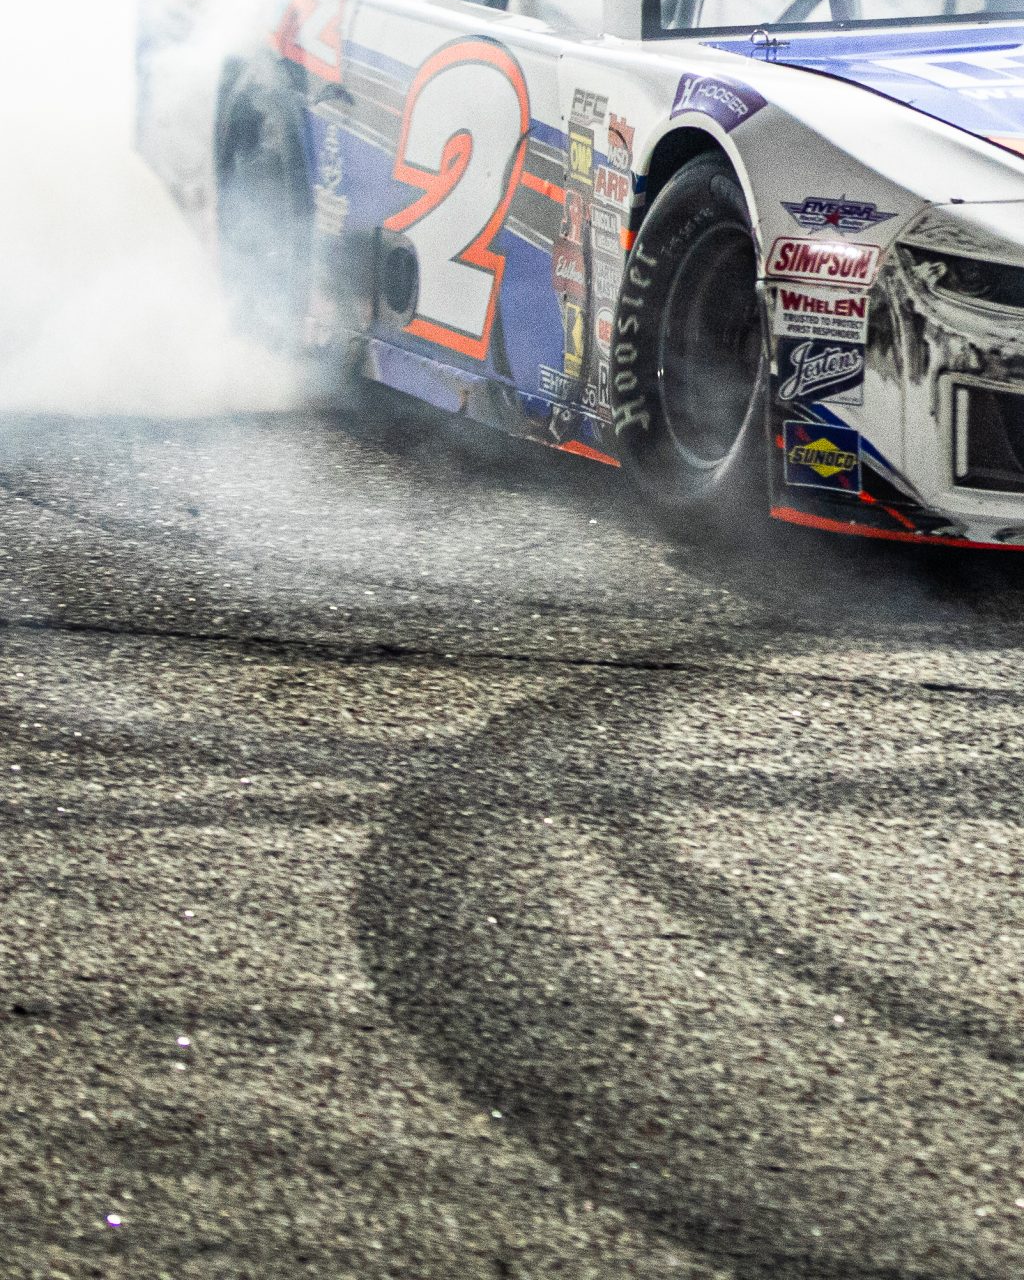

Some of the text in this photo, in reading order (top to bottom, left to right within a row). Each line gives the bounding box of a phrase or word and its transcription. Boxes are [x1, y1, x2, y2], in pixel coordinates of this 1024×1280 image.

[571, 87, 609, 118] PFC
[383, 34, 530, 361] 2
[594, 167, 630, 205] ARP
[773, 242, 874, 280] SIMPSON
[779, 288, 867, 319] WHELEN
[793, 445, 855, 469] SUNOCO
